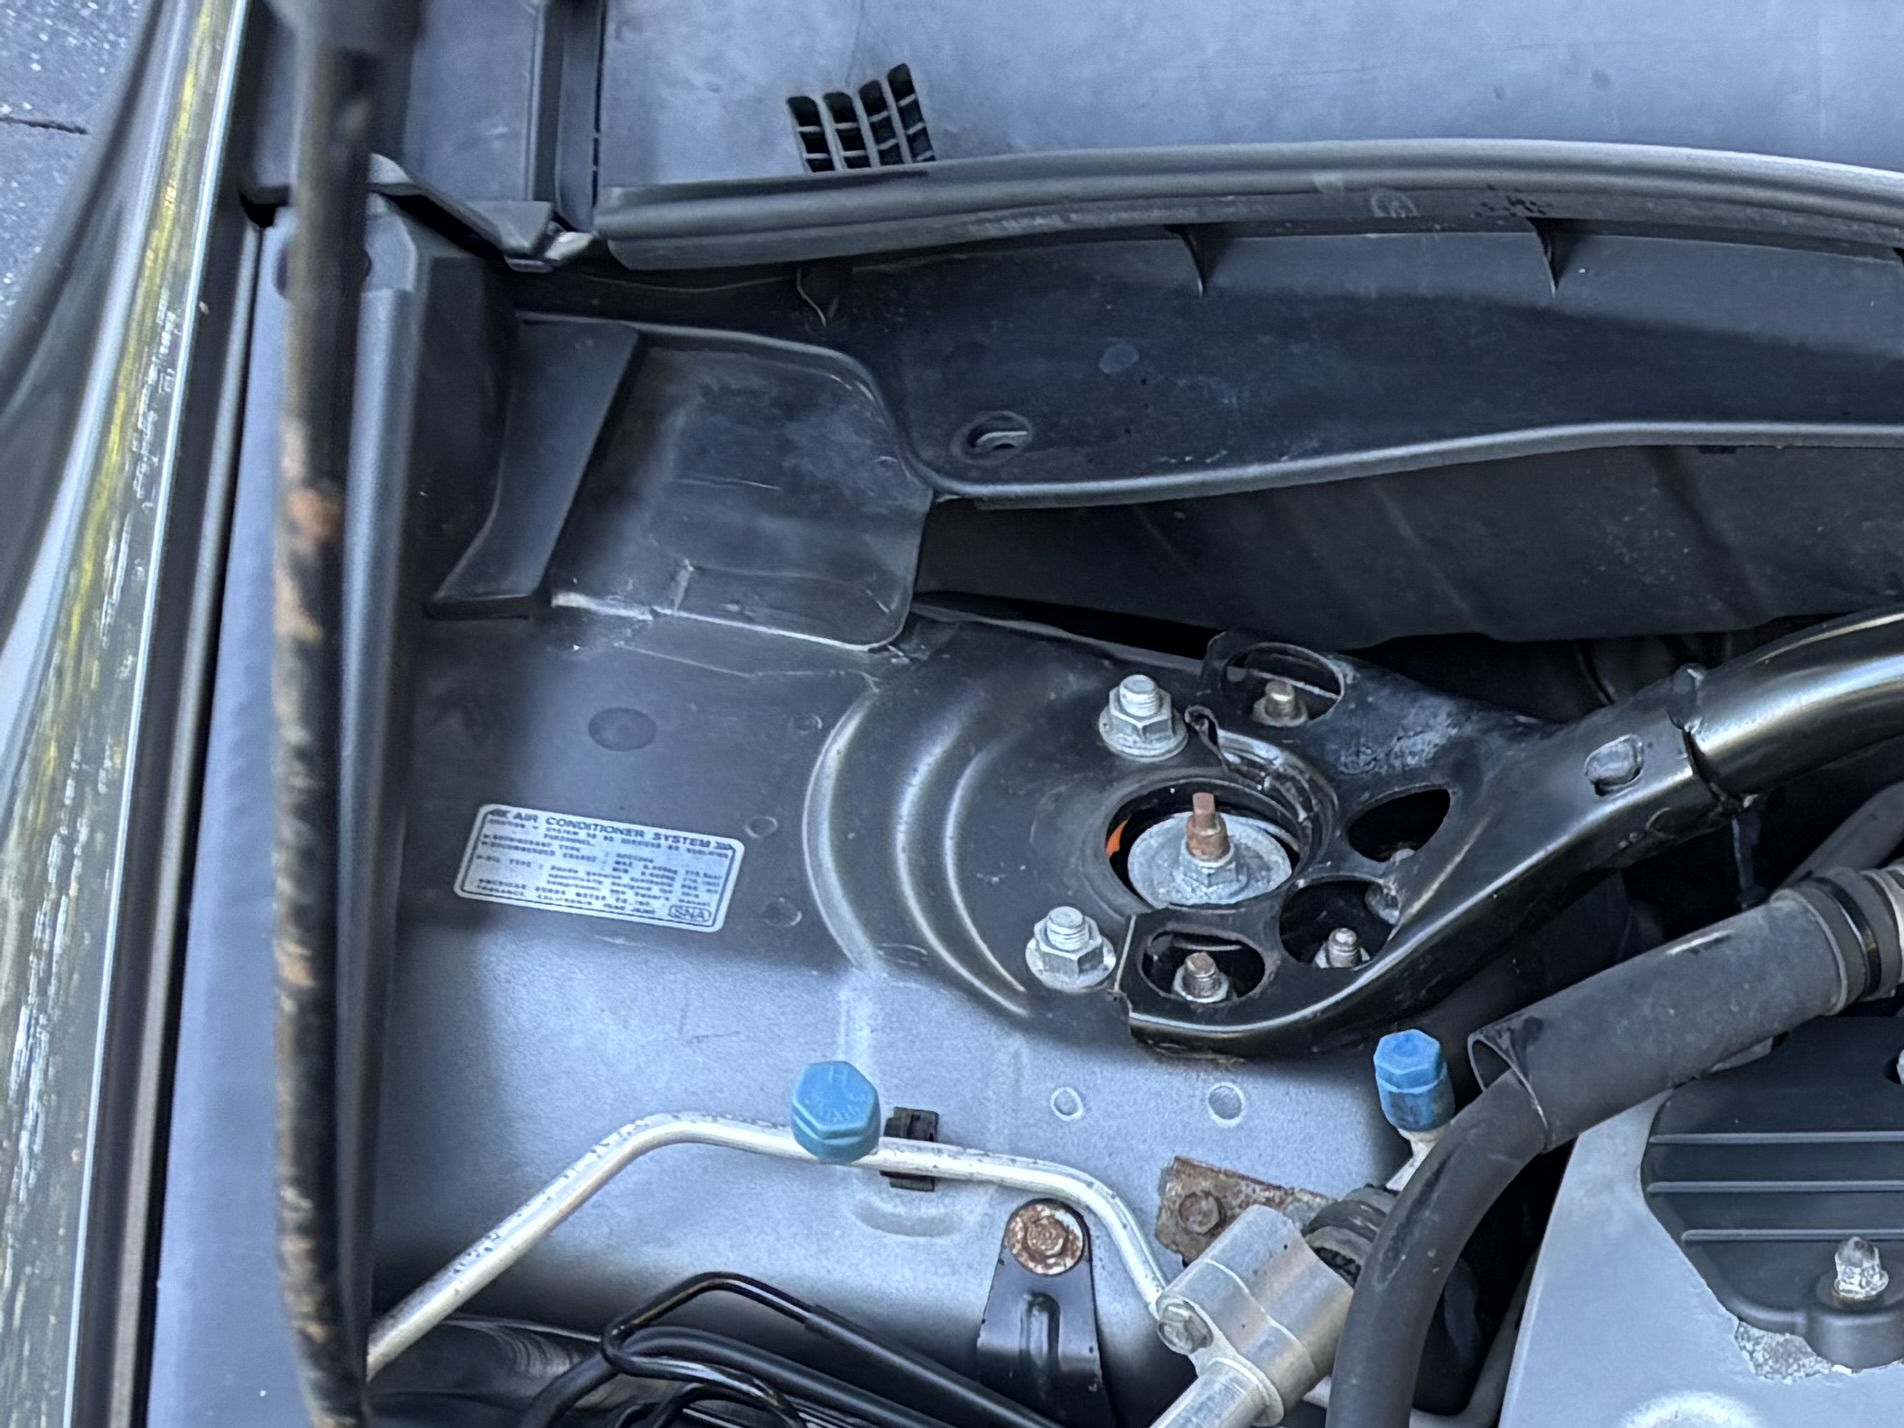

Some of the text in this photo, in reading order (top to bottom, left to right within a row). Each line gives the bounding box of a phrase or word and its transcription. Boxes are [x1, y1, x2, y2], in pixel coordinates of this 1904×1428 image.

[513, 811, 711, 848] AIR CONDITIONER SYSTEM
